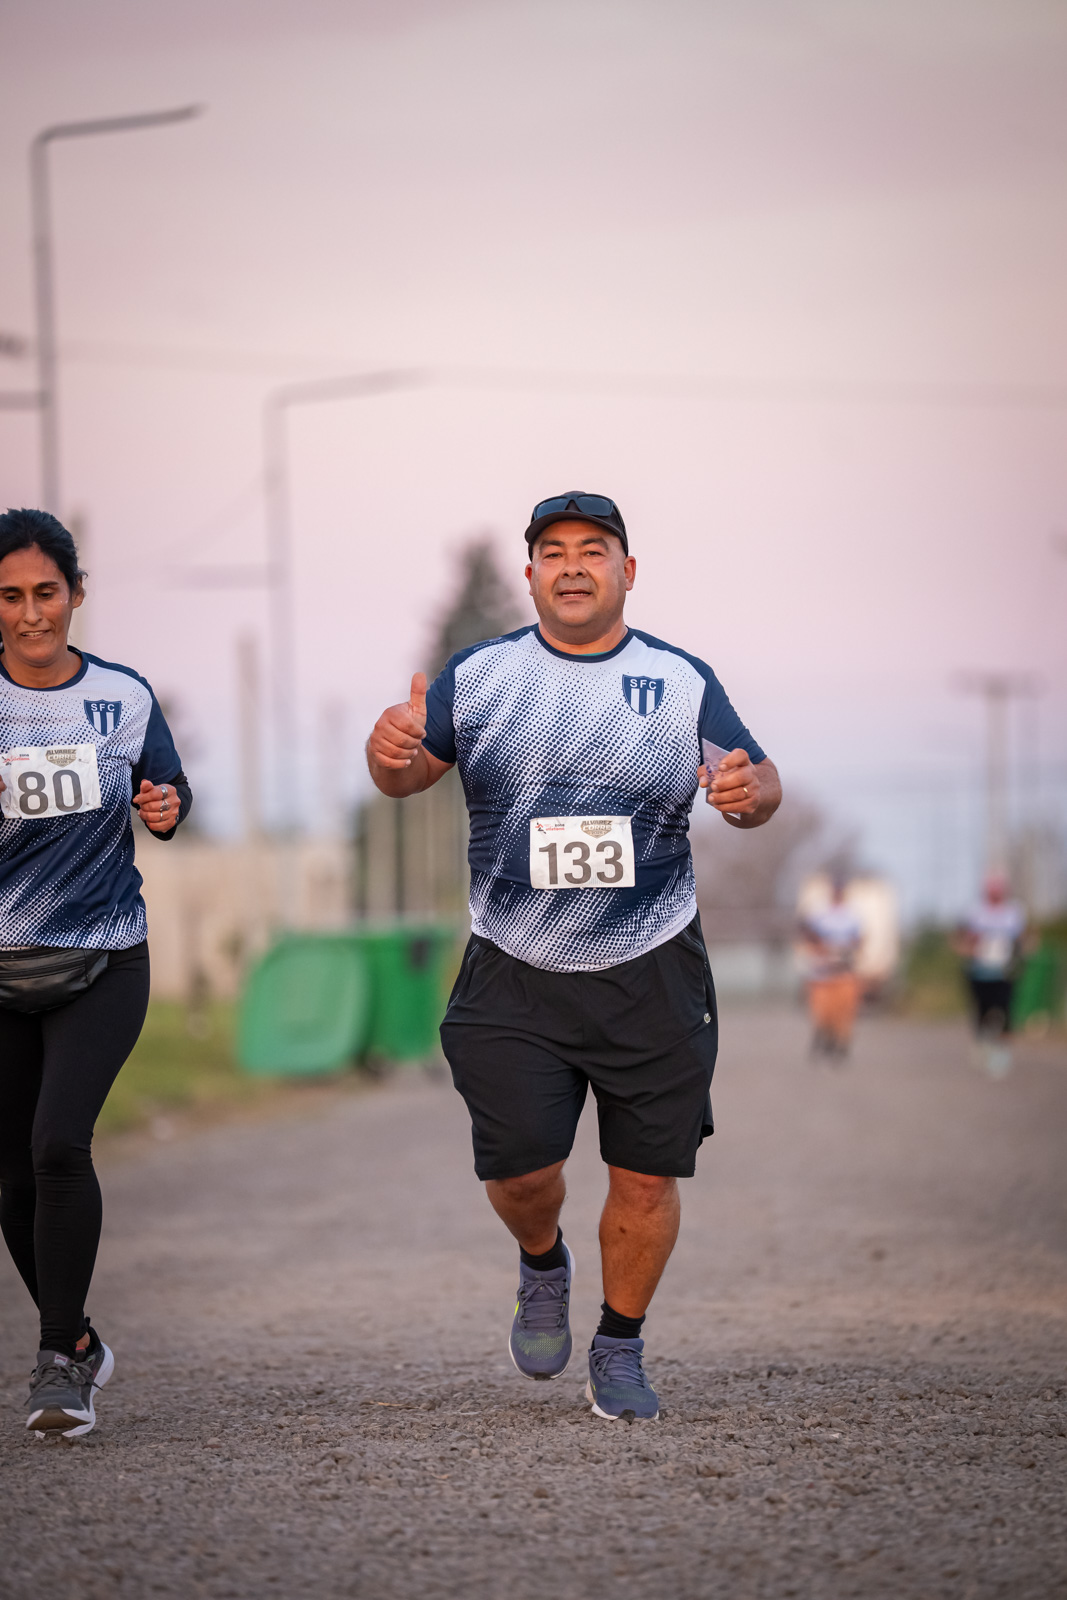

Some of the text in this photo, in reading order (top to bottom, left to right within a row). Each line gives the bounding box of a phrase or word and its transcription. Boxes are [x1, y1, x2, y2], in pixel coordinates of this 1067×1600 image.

[630, 678, 657, 690] SFC
[90, 703, 115, 712] SFC
[18, 769, 83, 816] 80
[539, 840, 624, 885] 133
